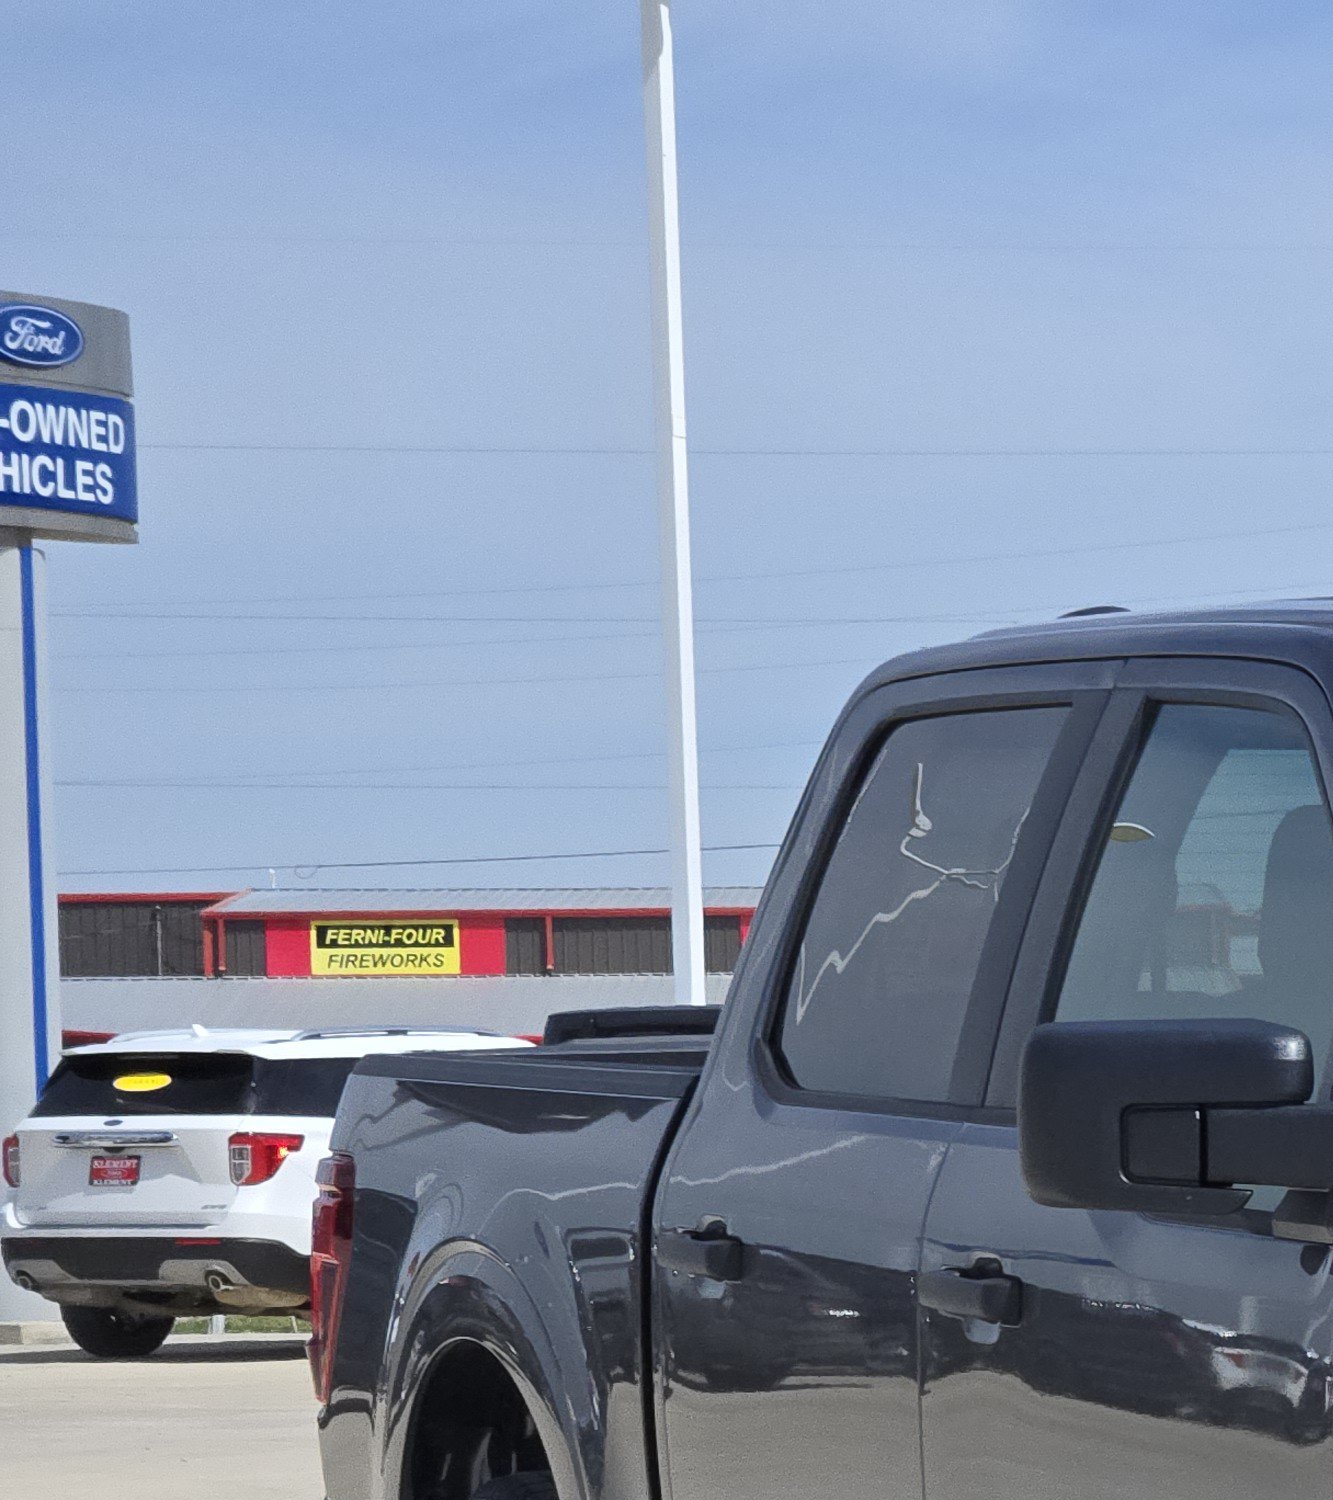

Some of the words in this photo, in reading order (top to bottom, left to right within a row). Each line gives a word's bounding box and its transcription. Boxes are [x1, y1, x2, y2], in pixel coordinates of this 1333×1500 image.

[4, 315, 66, 355] Ford
[0, 452, 114, 505] HICLES
[325, 928, 446, 945] FERNI-FOUR
[327, 953, 445, 969] FIREWORKS
